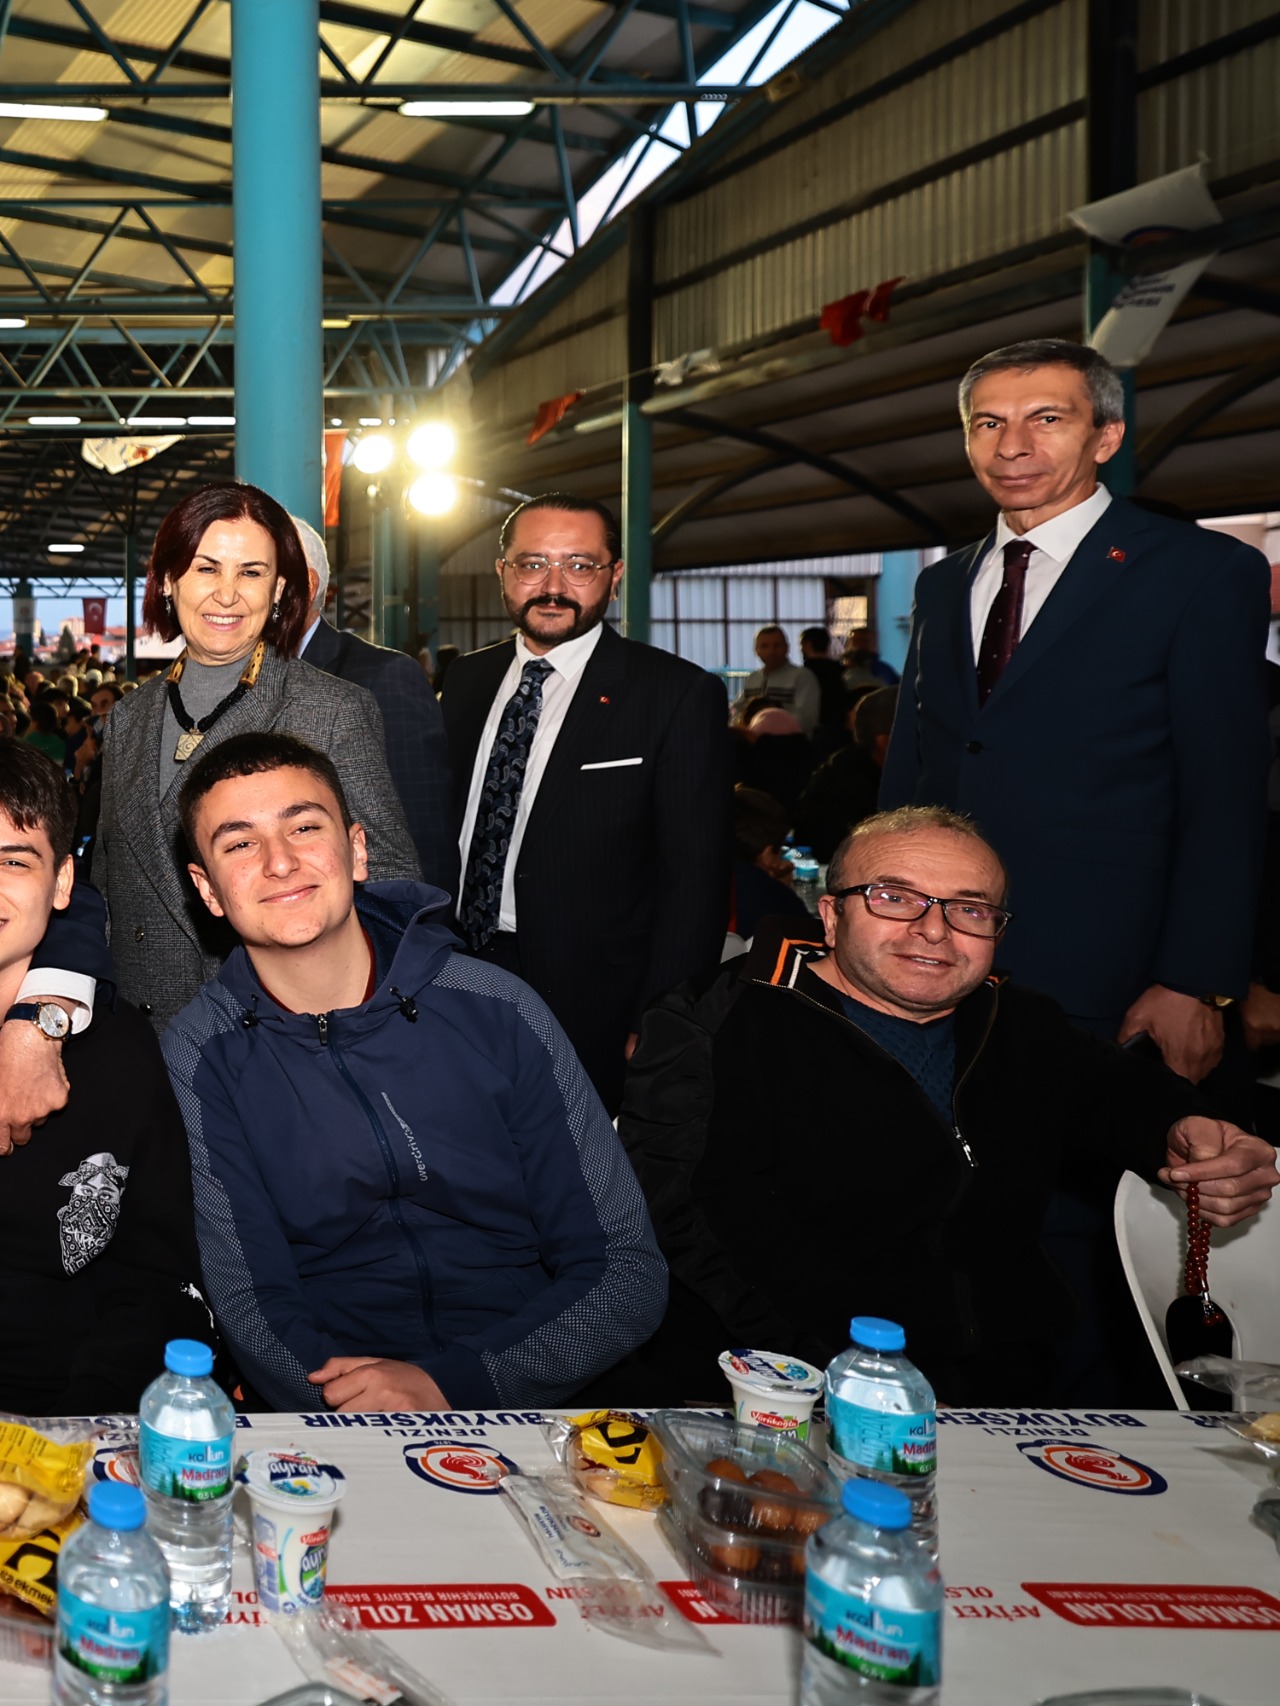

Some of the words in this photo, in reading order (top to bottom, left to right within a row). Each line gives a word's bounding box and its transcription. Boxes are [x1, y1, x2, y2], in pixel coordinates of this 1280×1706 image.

[181, 1467, 228, 1481] Madran
[269, 1460, 319, 1477] ayran
[431, 1603, 535, 1621] OSMAN
[951, 1605, 1042, 1622] AFİYET
[1063, 1602, 1174, 1622] ZOLAN
